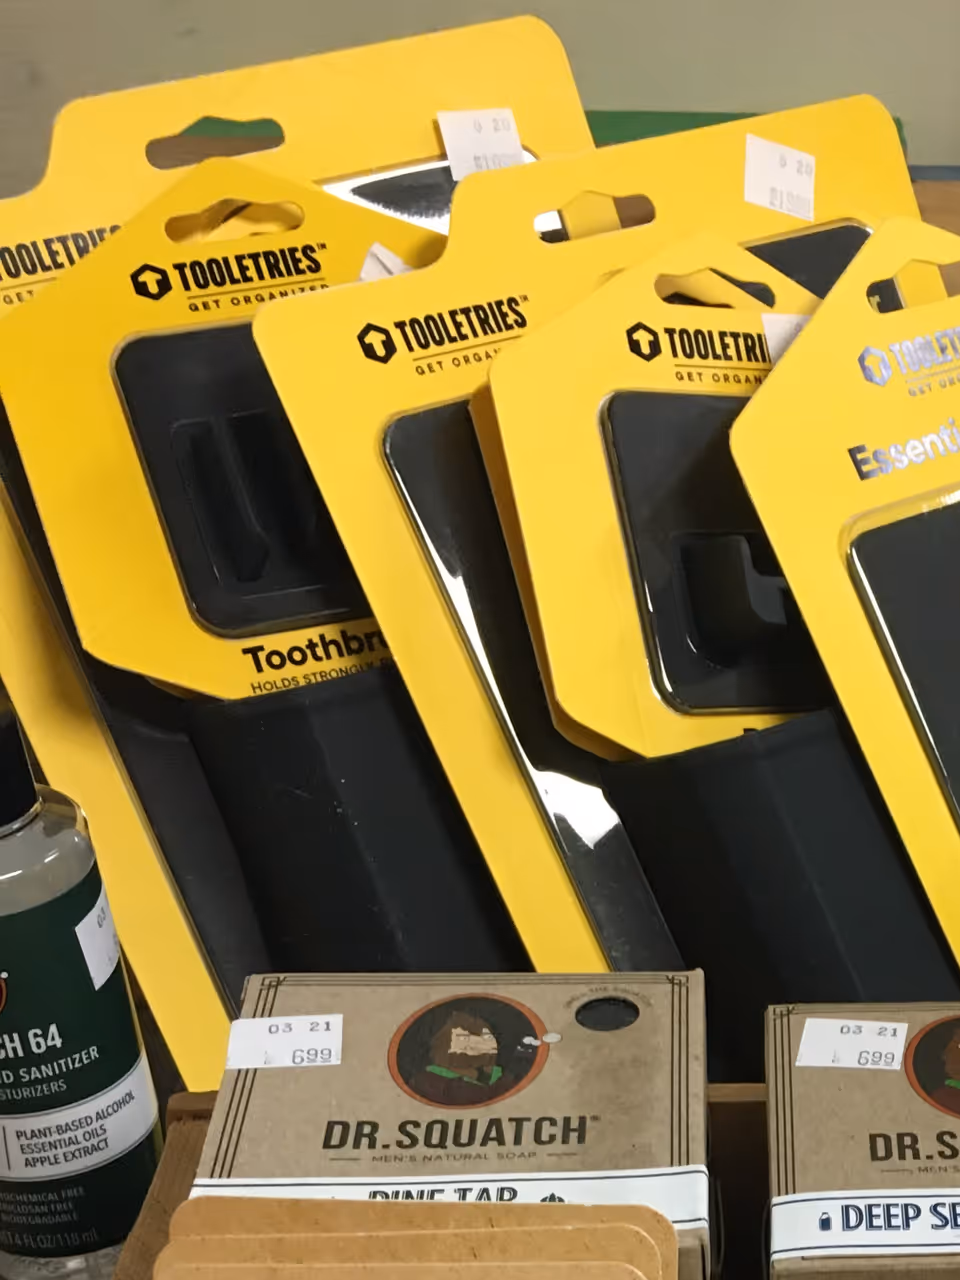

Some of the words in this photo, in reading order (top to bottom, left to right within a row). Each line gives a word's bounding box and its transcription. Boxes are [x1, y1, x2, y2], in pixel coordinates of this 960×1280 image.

[172, 244, 322, 292] TOOLETRIES
[3, 289, 34, 306] GET
[188, 299, 221, 312] GET
[394, 296, 528, 352] TOOLETRIES
[664, 327, 772, 364] TOOLETRI
[415, 360, 445, 376] GET
[675, 371, 703, 382] GET
[908, 384, 934, 397] GET
[241, 630, 389, 674] Toothbr
[250, 676, 300, 694] HOLDS
[27, 1023, 62, 1054] 64
[268, 1022, 293, 1034] 03
[309, 1021, 332, 1032] 21
[840, 1024, 863, 1035] 03
[877, 1026, 898, 1037] 21
[19, 1045, 100, 1082] SANITIZER
[291, 1048, 333, 1065] 699
[857, 1050, 895, 1067] 699
[15, 1115, 94, 1141] PLANT-BASED
[96, 1090, 135, 1123] ALCOHOL
[20, 1135, 81, 1155] ESSENTIAL
[83, 1124, 107, 1141] OILS
[322, 1116, 588, 1150] DR.SQUATCH
[24, 1154, 60, 1168] APPLE
[63, 1137, 109, 1162] EXTRACT
[423, 1153, 489, 1162] NATURAL
[497, 1151, 537, 1159] SOAP
[841, 1202, 922, 1232] DEEP
